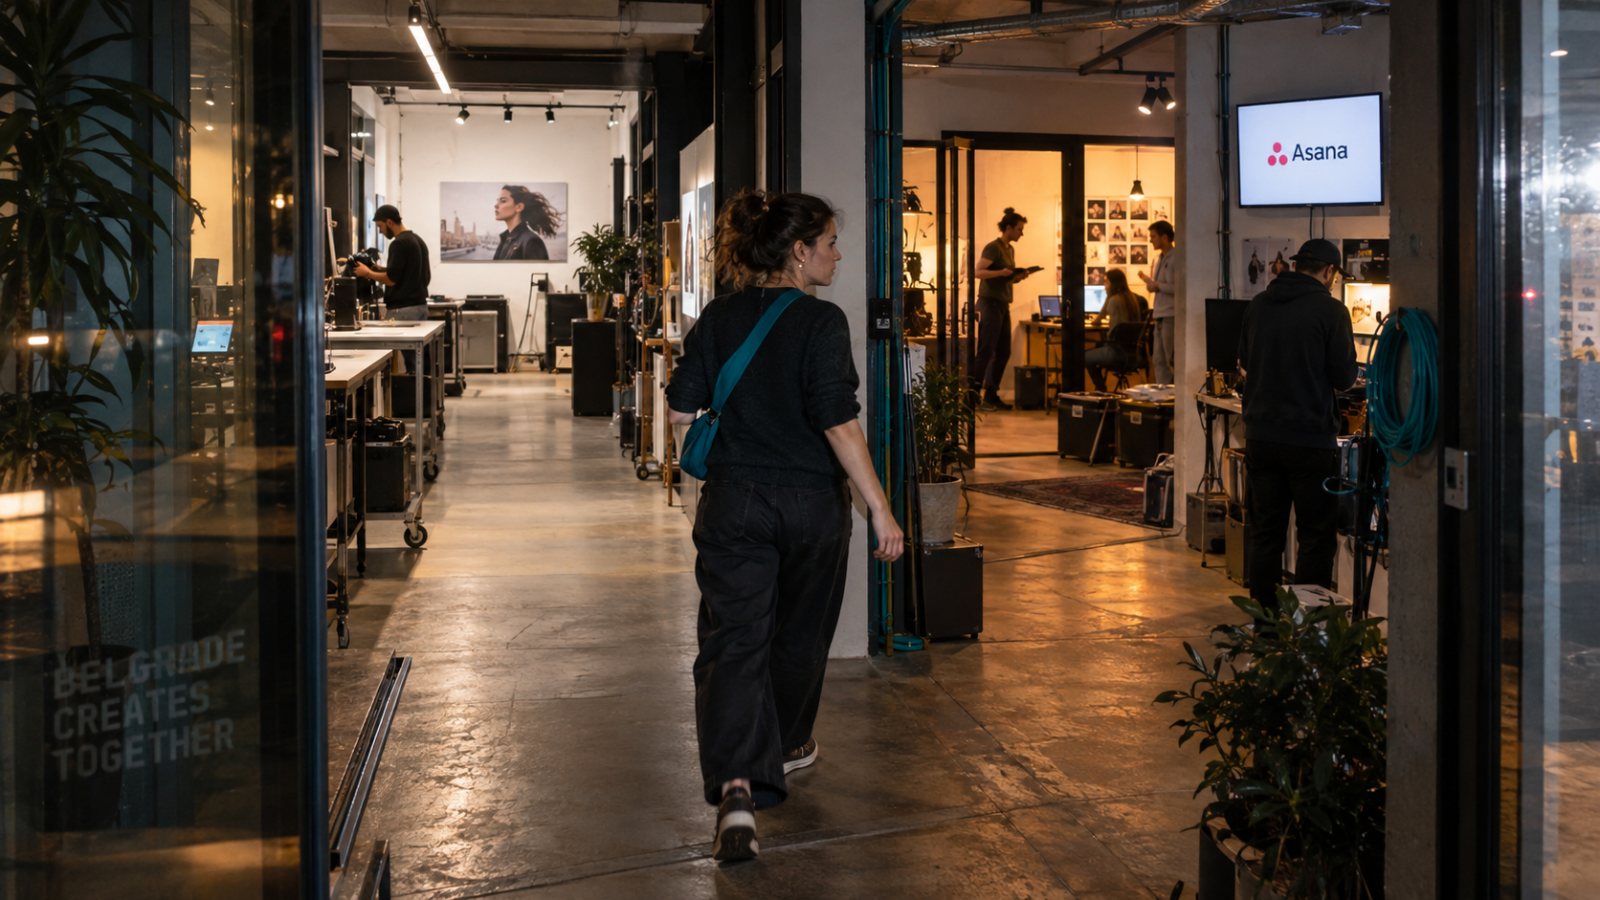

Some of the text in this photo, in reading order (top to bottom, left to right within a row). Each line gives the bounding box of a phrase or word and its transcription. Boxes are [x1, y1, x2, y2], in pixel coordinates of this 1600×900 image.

[1292, 143, 1348, 161] Asana
[53, 629, 246, 699] BELGRADE
[53, 681, 210, 740] CREATES
[52, 718, 235, 781] TOGETHER
